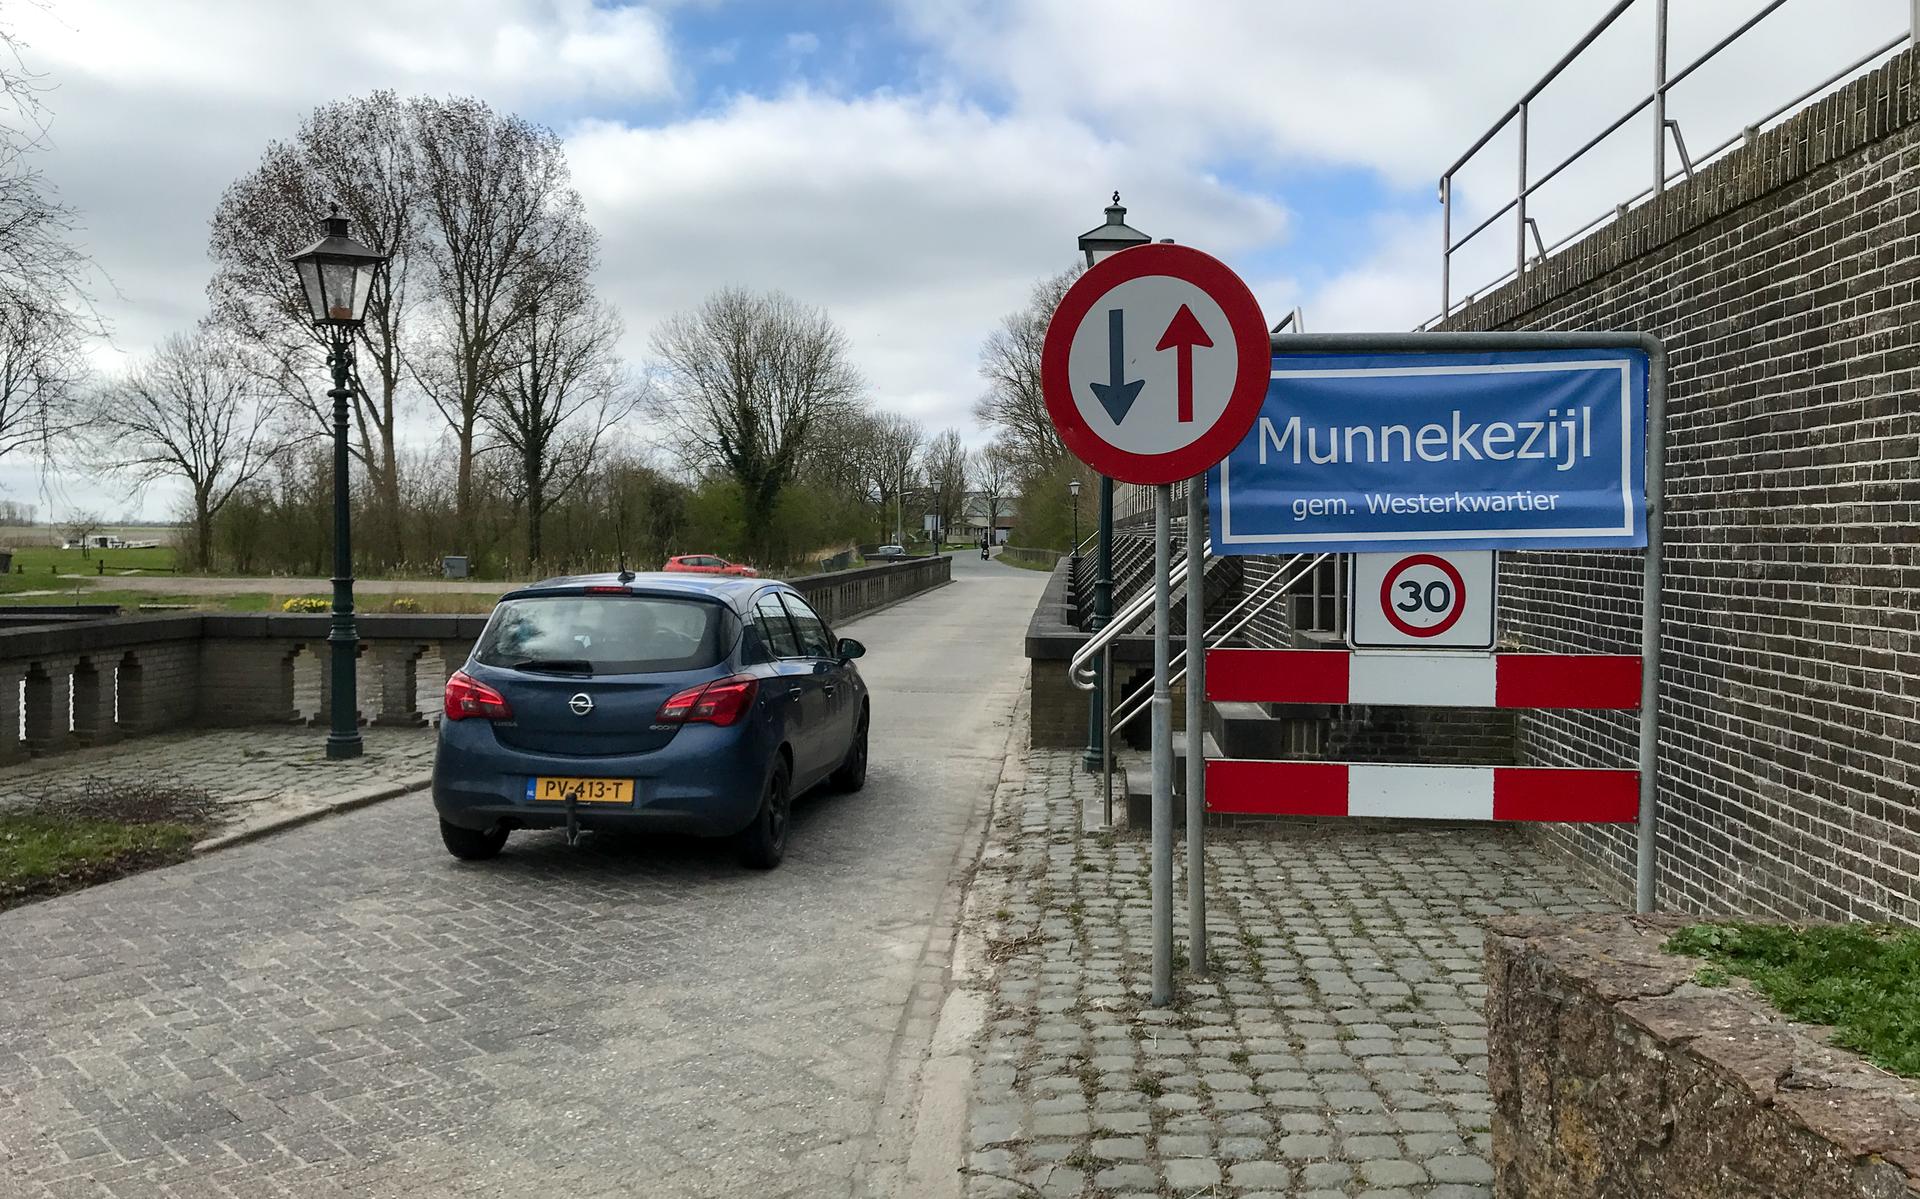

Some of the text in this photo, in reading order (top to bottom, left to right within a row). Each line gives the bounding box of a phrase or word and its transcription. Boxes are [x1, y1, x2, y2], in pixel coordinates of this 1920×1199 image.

[1258, 406, 1591, 471] Munnekezijl
[1292, 491, 1559, 521] gem. Westerkwartier
[1396, 580, 1450, 613] 30
[545, 781, 623, 799] PV-413-T
